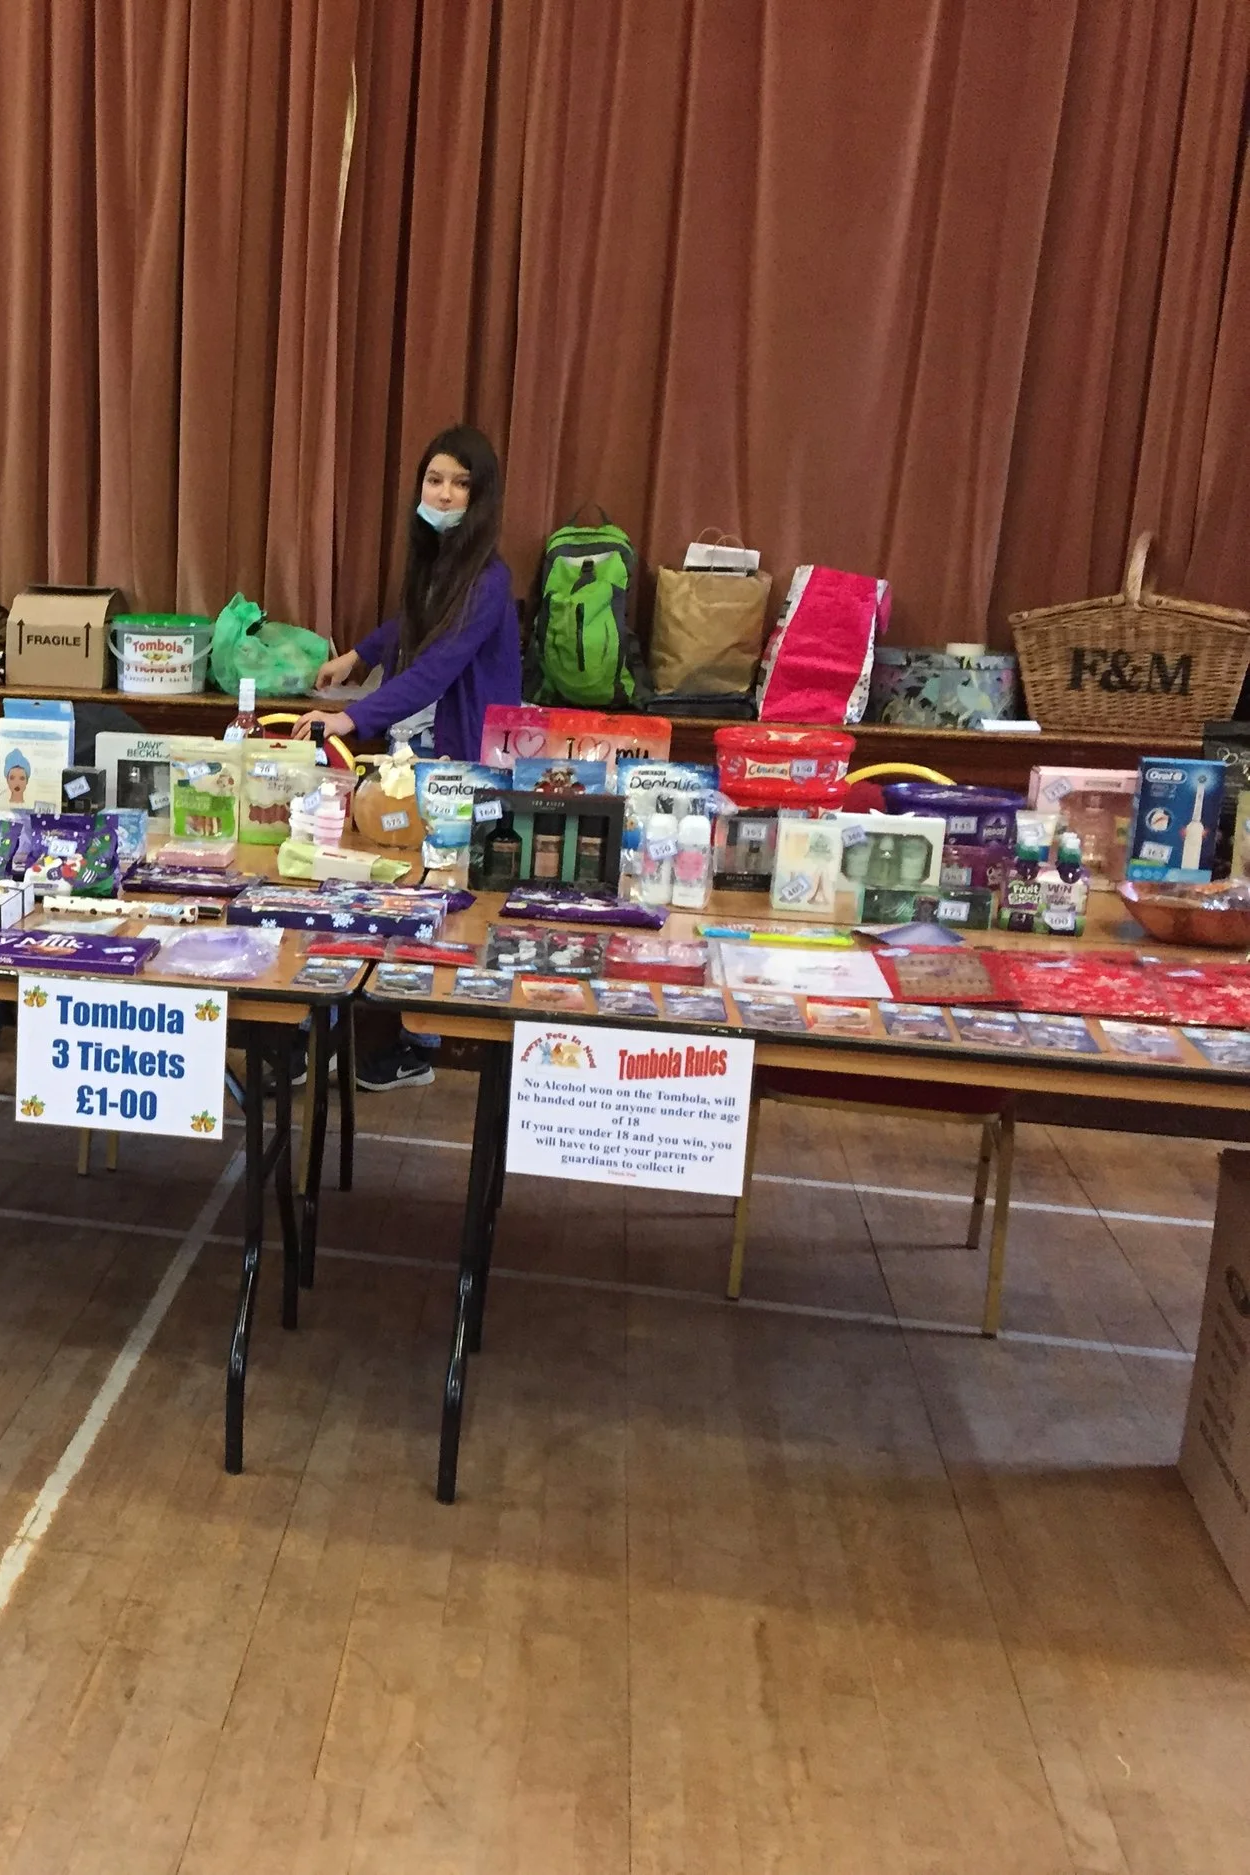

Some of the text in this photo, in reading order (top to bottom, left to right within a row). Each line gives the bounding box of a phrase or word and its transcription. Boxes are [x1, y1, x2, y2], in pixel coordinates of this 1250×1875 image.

[26, 634, 81, 648] FRAGILE
[133, 639, 183, 654] Tombola
[1068, 647, 1192, 696] F&M
[501, 730, 512, 754] I
[1013, 884, 1040, 894] Fruit
[13, 932, 87, 949] Milk
[56, 994, 184, 1034] Tombola
[52, 1038, 185, 1079] 3 Tickets
[521, 1032, 597, 1068] Powys Pets In Need
[619, 1045, 728, 1080] Tombola Rules
[76, 1084, 158, 1120] £1-00
[524, 1078, 736, 1107] No Alcohol won on the Tombola, will
[517, 1092, 741, 1124] be handed out to anyone under the age
[611, 1116, 640, 1127] of 18
[521, 1120, 732, 1150] If you are under 18 and you win, you
[535, 1136, 715, 1163] will have to get your parents or
[561, 1154, 686, 1175] guardians to collect it
